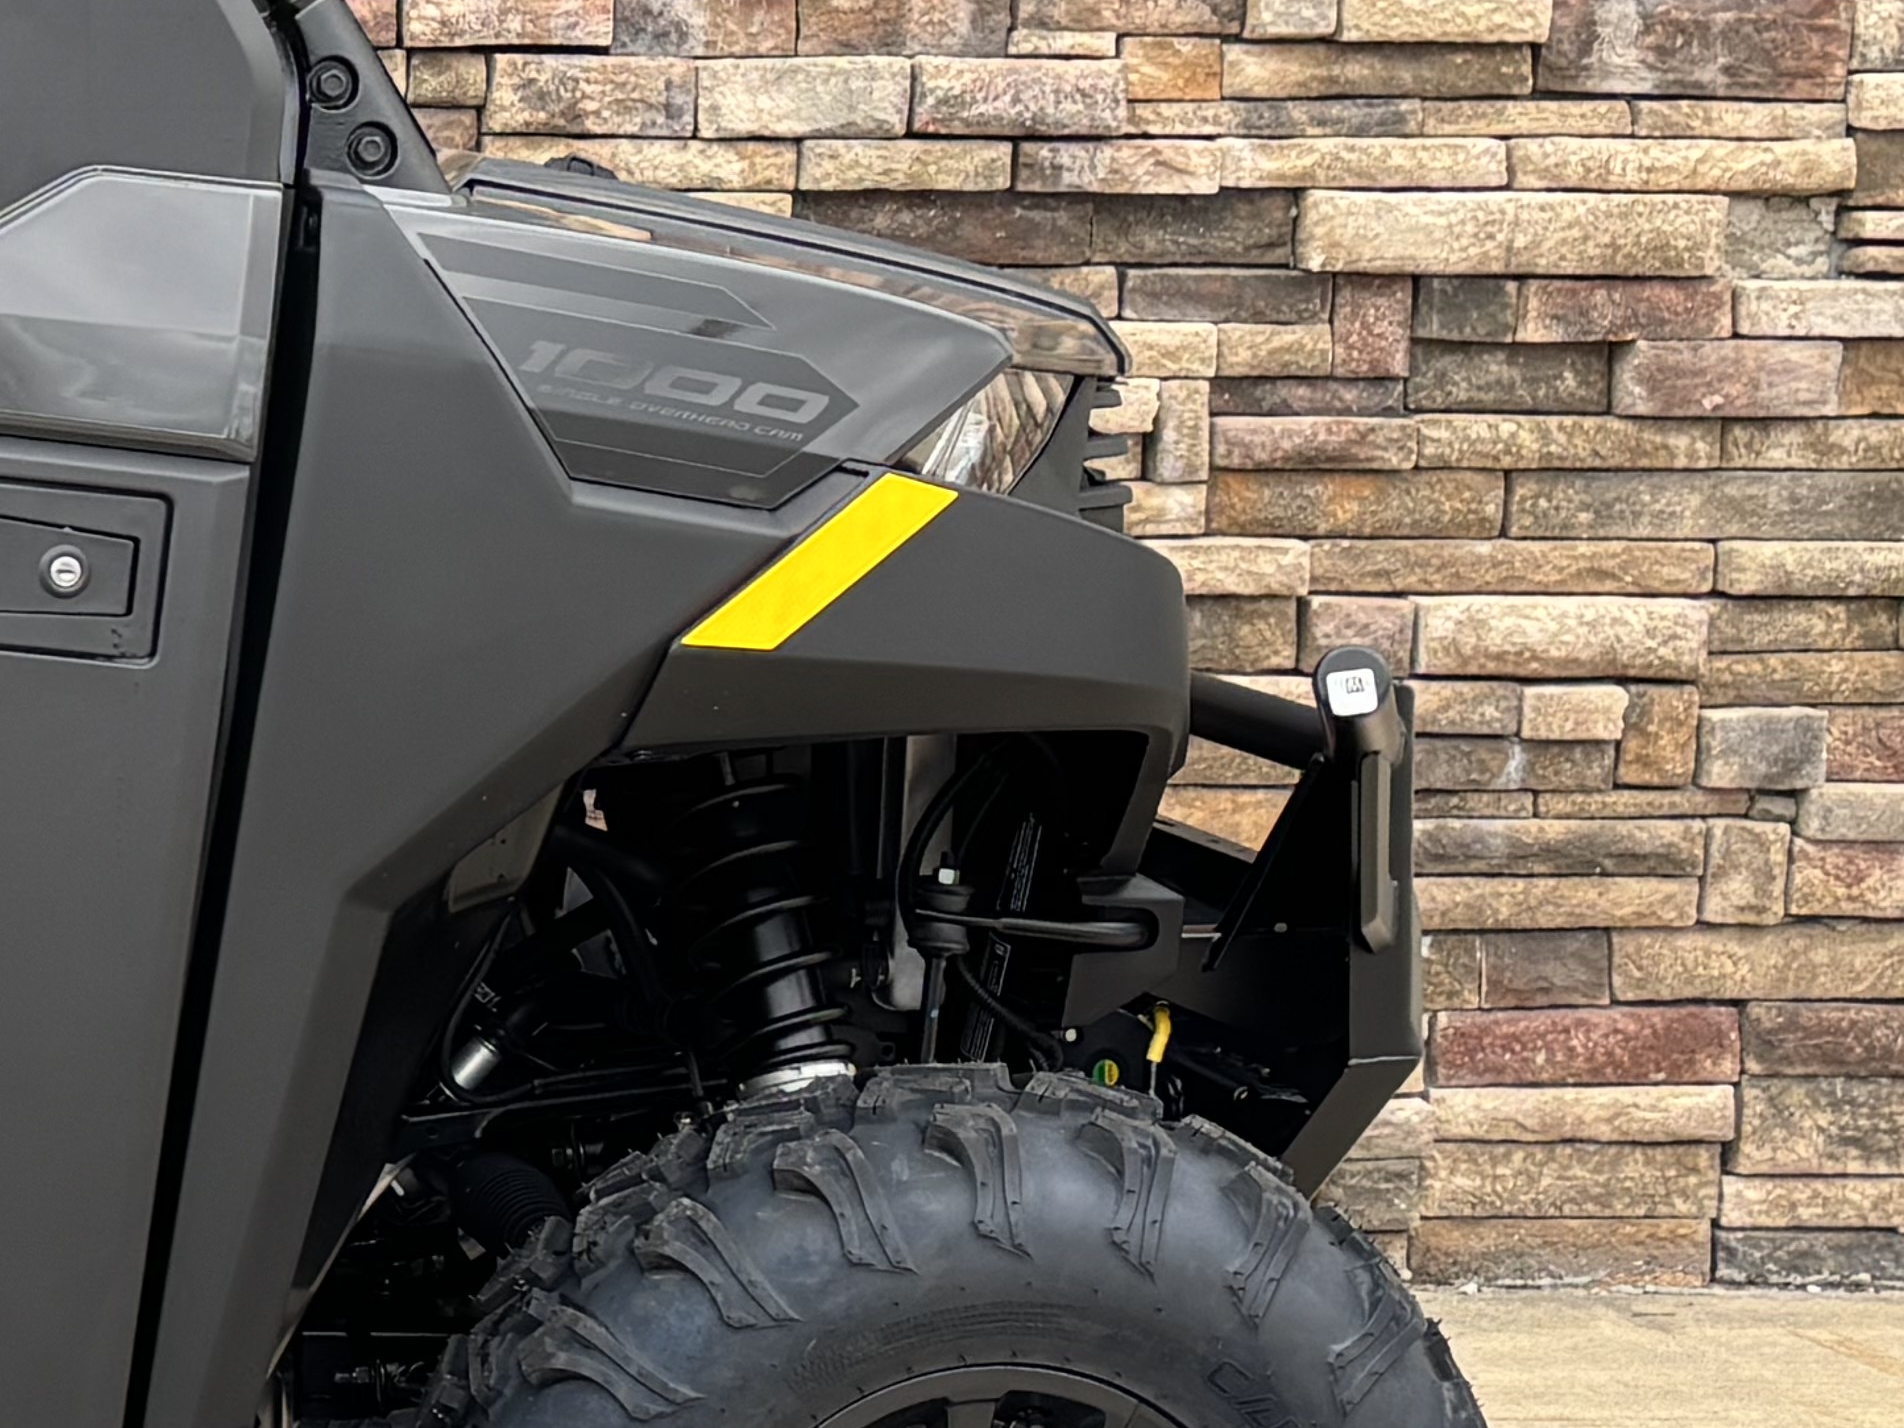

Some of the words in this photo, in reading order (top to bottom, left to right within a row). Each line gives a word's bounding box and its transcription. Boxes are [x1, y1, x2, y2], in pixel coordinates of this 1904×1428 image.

[518, 341, 829, 424] 1000
[537, 384, 622, 408] SINGLE
[629, 400, 750, 432] OVERHEAD
[753, 425, 804, 441] CAM
